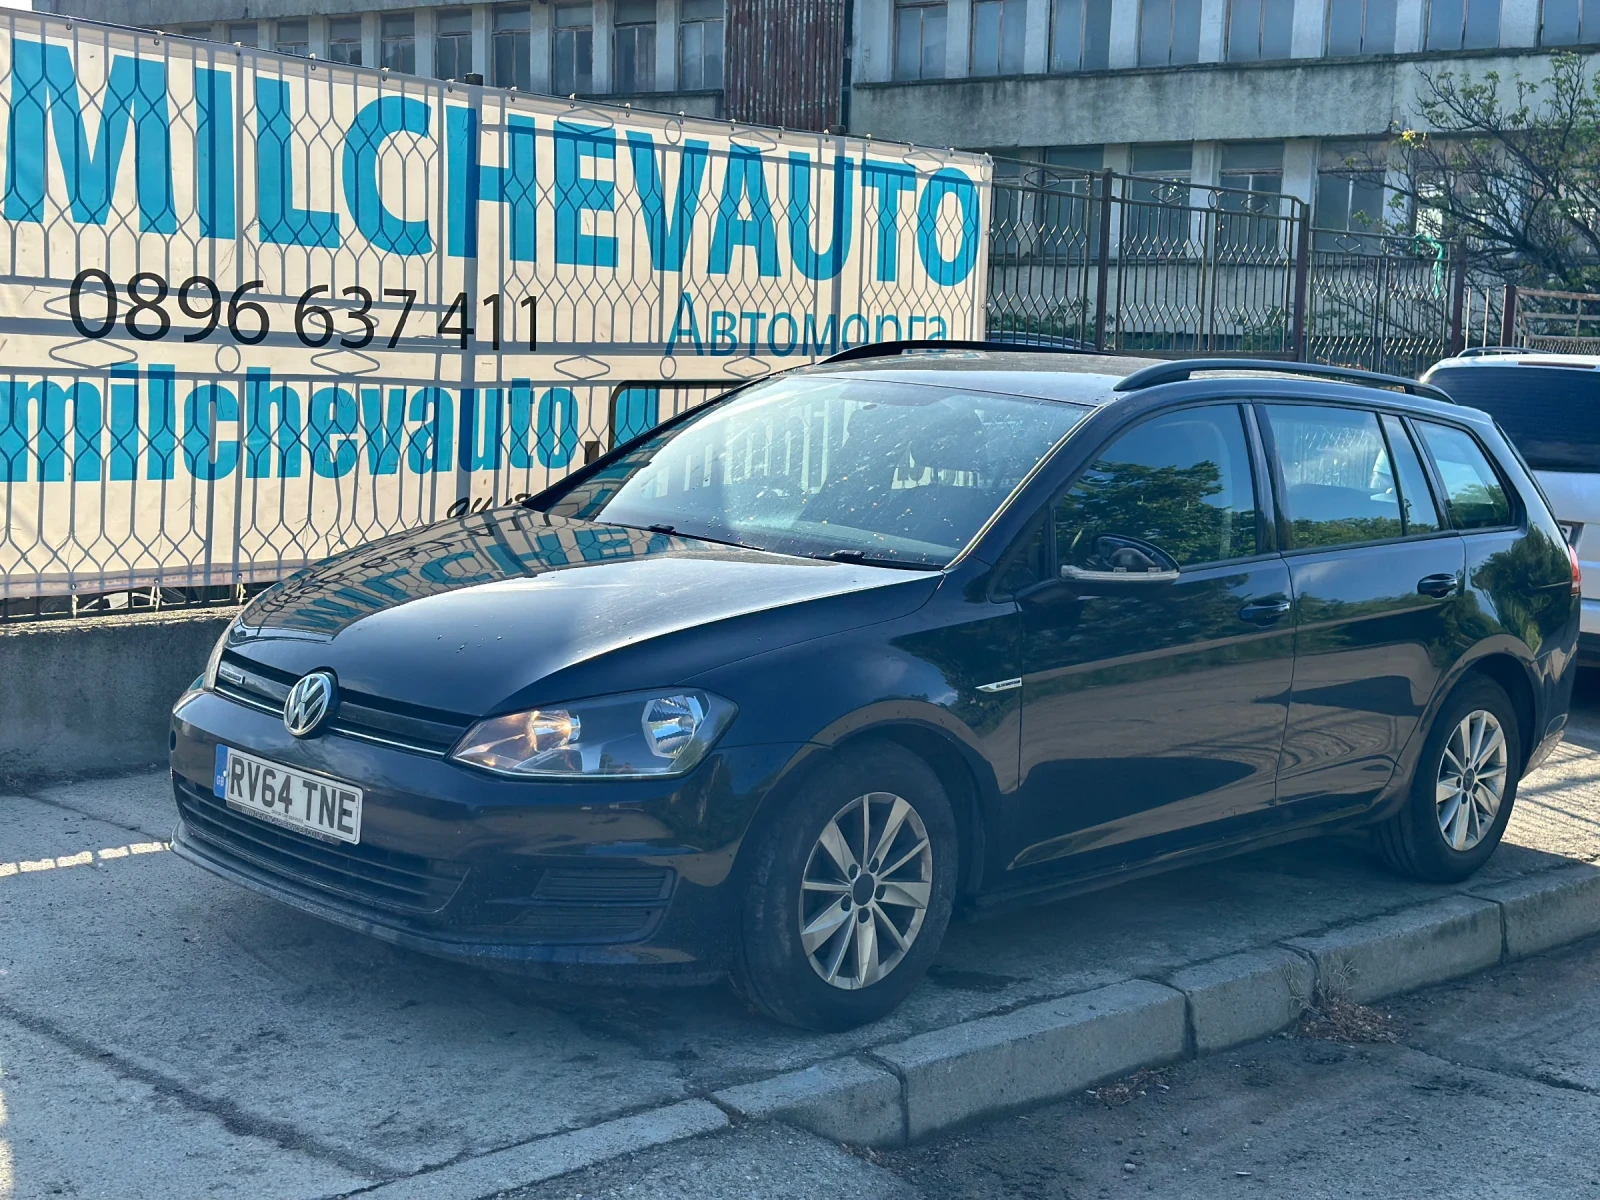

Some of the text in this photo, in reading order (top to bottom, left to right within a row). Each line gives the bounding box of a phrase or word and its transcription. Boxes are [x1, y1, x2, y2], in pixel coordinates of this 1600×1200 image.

[4, 38, 981, 286] MILCHEVAUTO
[69, 268, 538, 352] 0896 637 411
[230, 756, 356, 835] RV64 TNE
